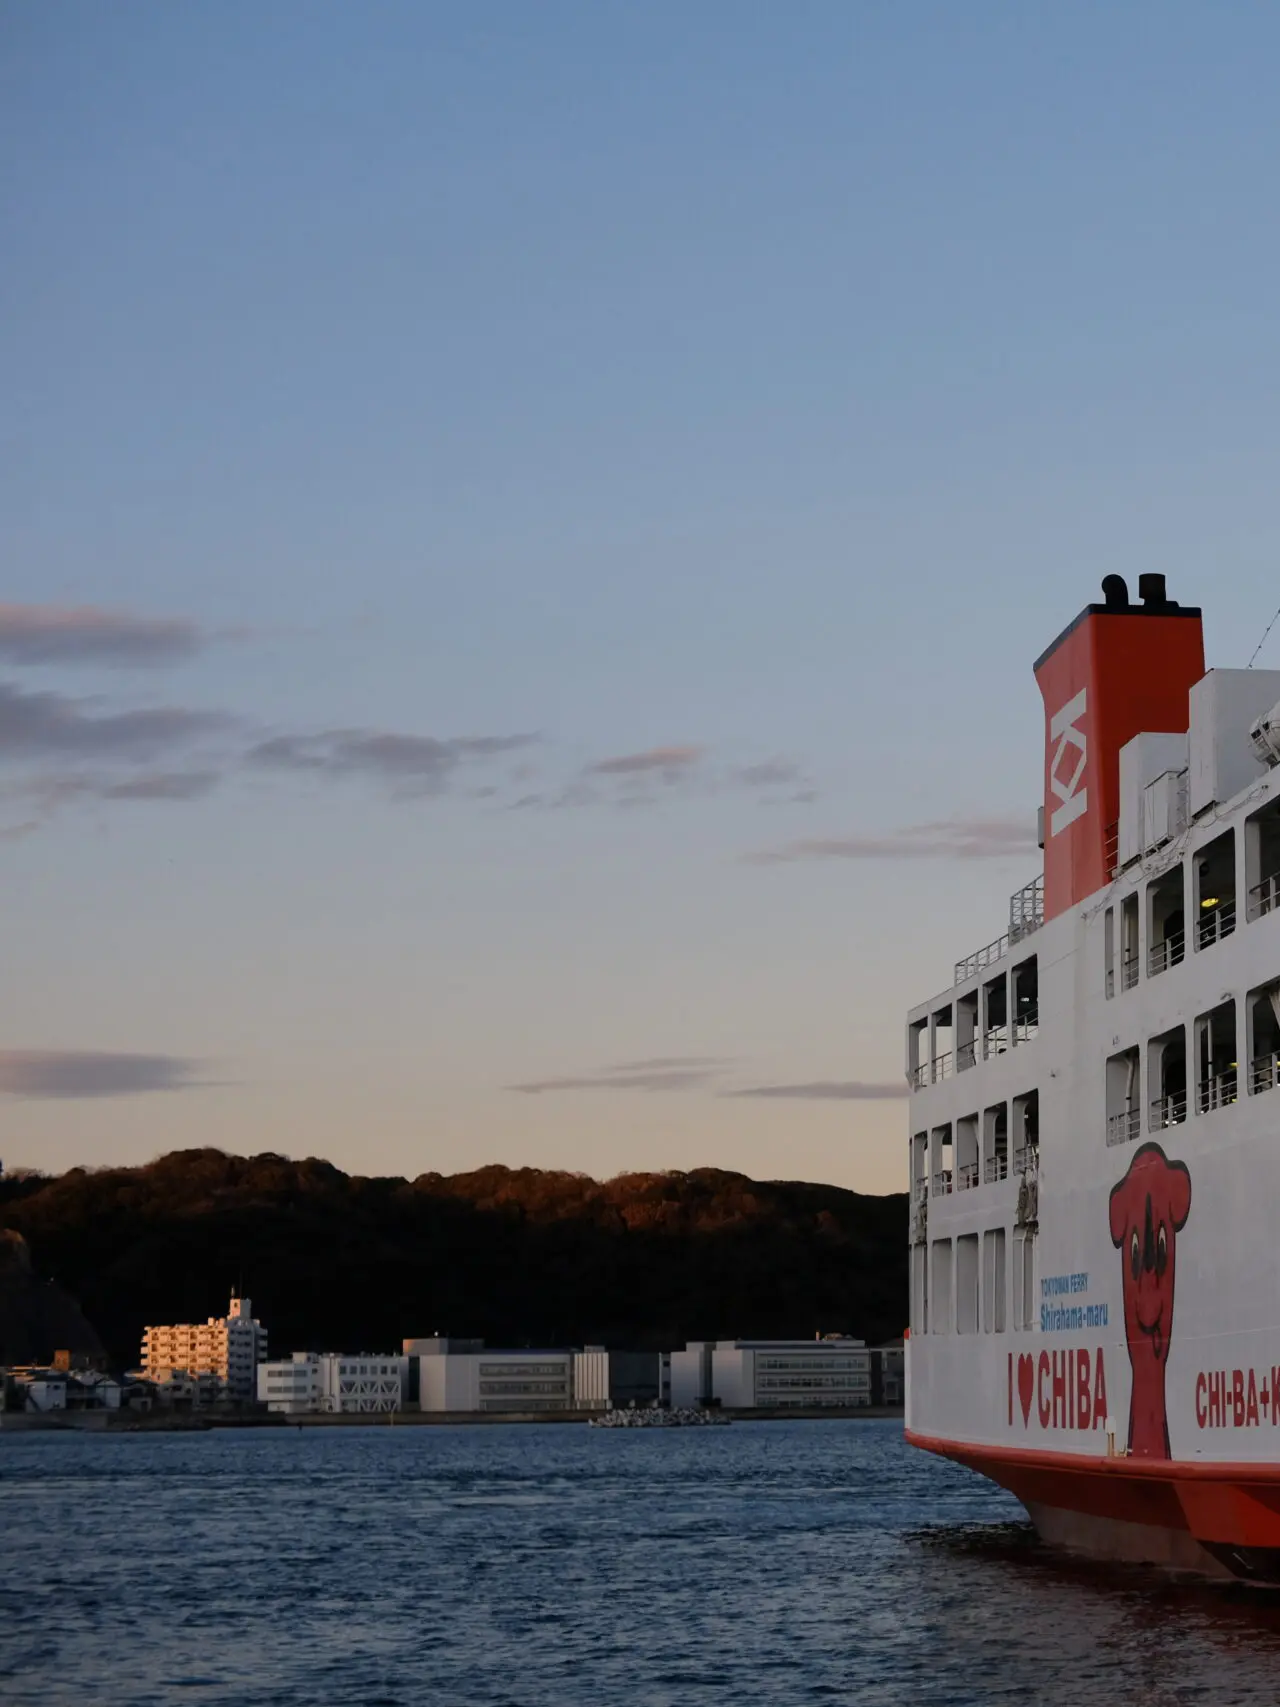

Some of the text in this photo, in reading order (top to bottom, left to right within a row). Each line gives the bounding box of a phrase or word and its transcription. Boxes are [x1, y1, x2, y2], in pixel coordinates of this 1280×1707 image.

[1071, 1273, 1089, 1293] FERRY
[1041, 1302, 1108, 1332] Shirahama-maru
[1008, 1347, 1108, 1430] I CHIBA
